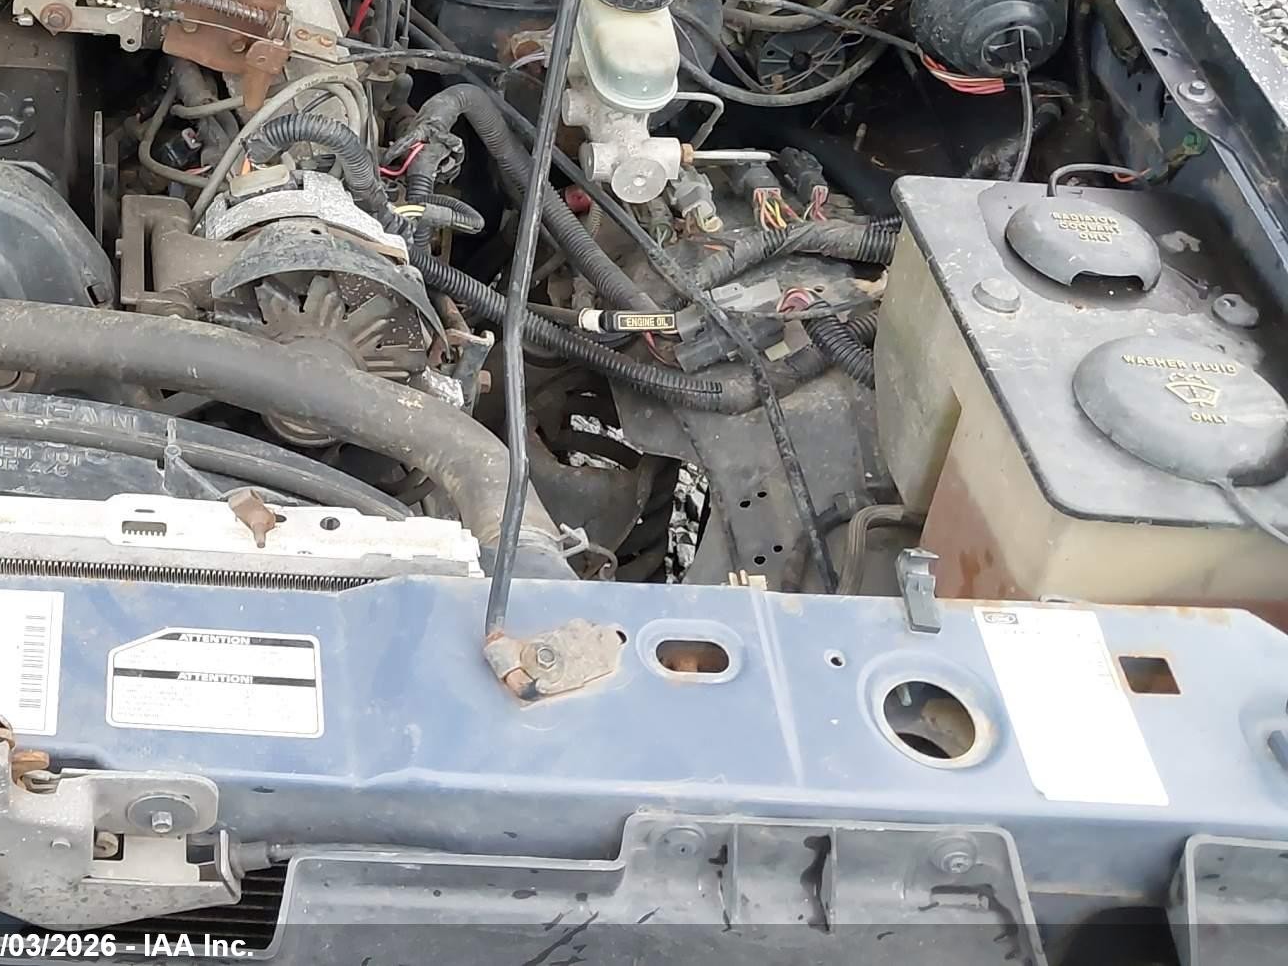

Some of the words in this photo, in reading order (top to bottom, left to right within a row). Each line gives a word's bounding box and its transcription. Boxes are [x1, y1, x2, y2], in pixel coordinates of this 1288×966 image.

[1050, 212, 1118, 225] RADIATOR
[1058, 221, 1121, 235] COOLANT
[1078, 233, 1112, 243] ONLY
[626, 317, 655, 327] ENGINE
[656, 317, 669, 327] OIL
[1121, 354, 1188, 371] WASHER
[1190, 361, 1238, 376] FLUID
[1190, 411, 1229, 425] ONLY
[177, 634, 251, 645] ATTENTION
[177, 673, 254, 684] ATTENTION!
